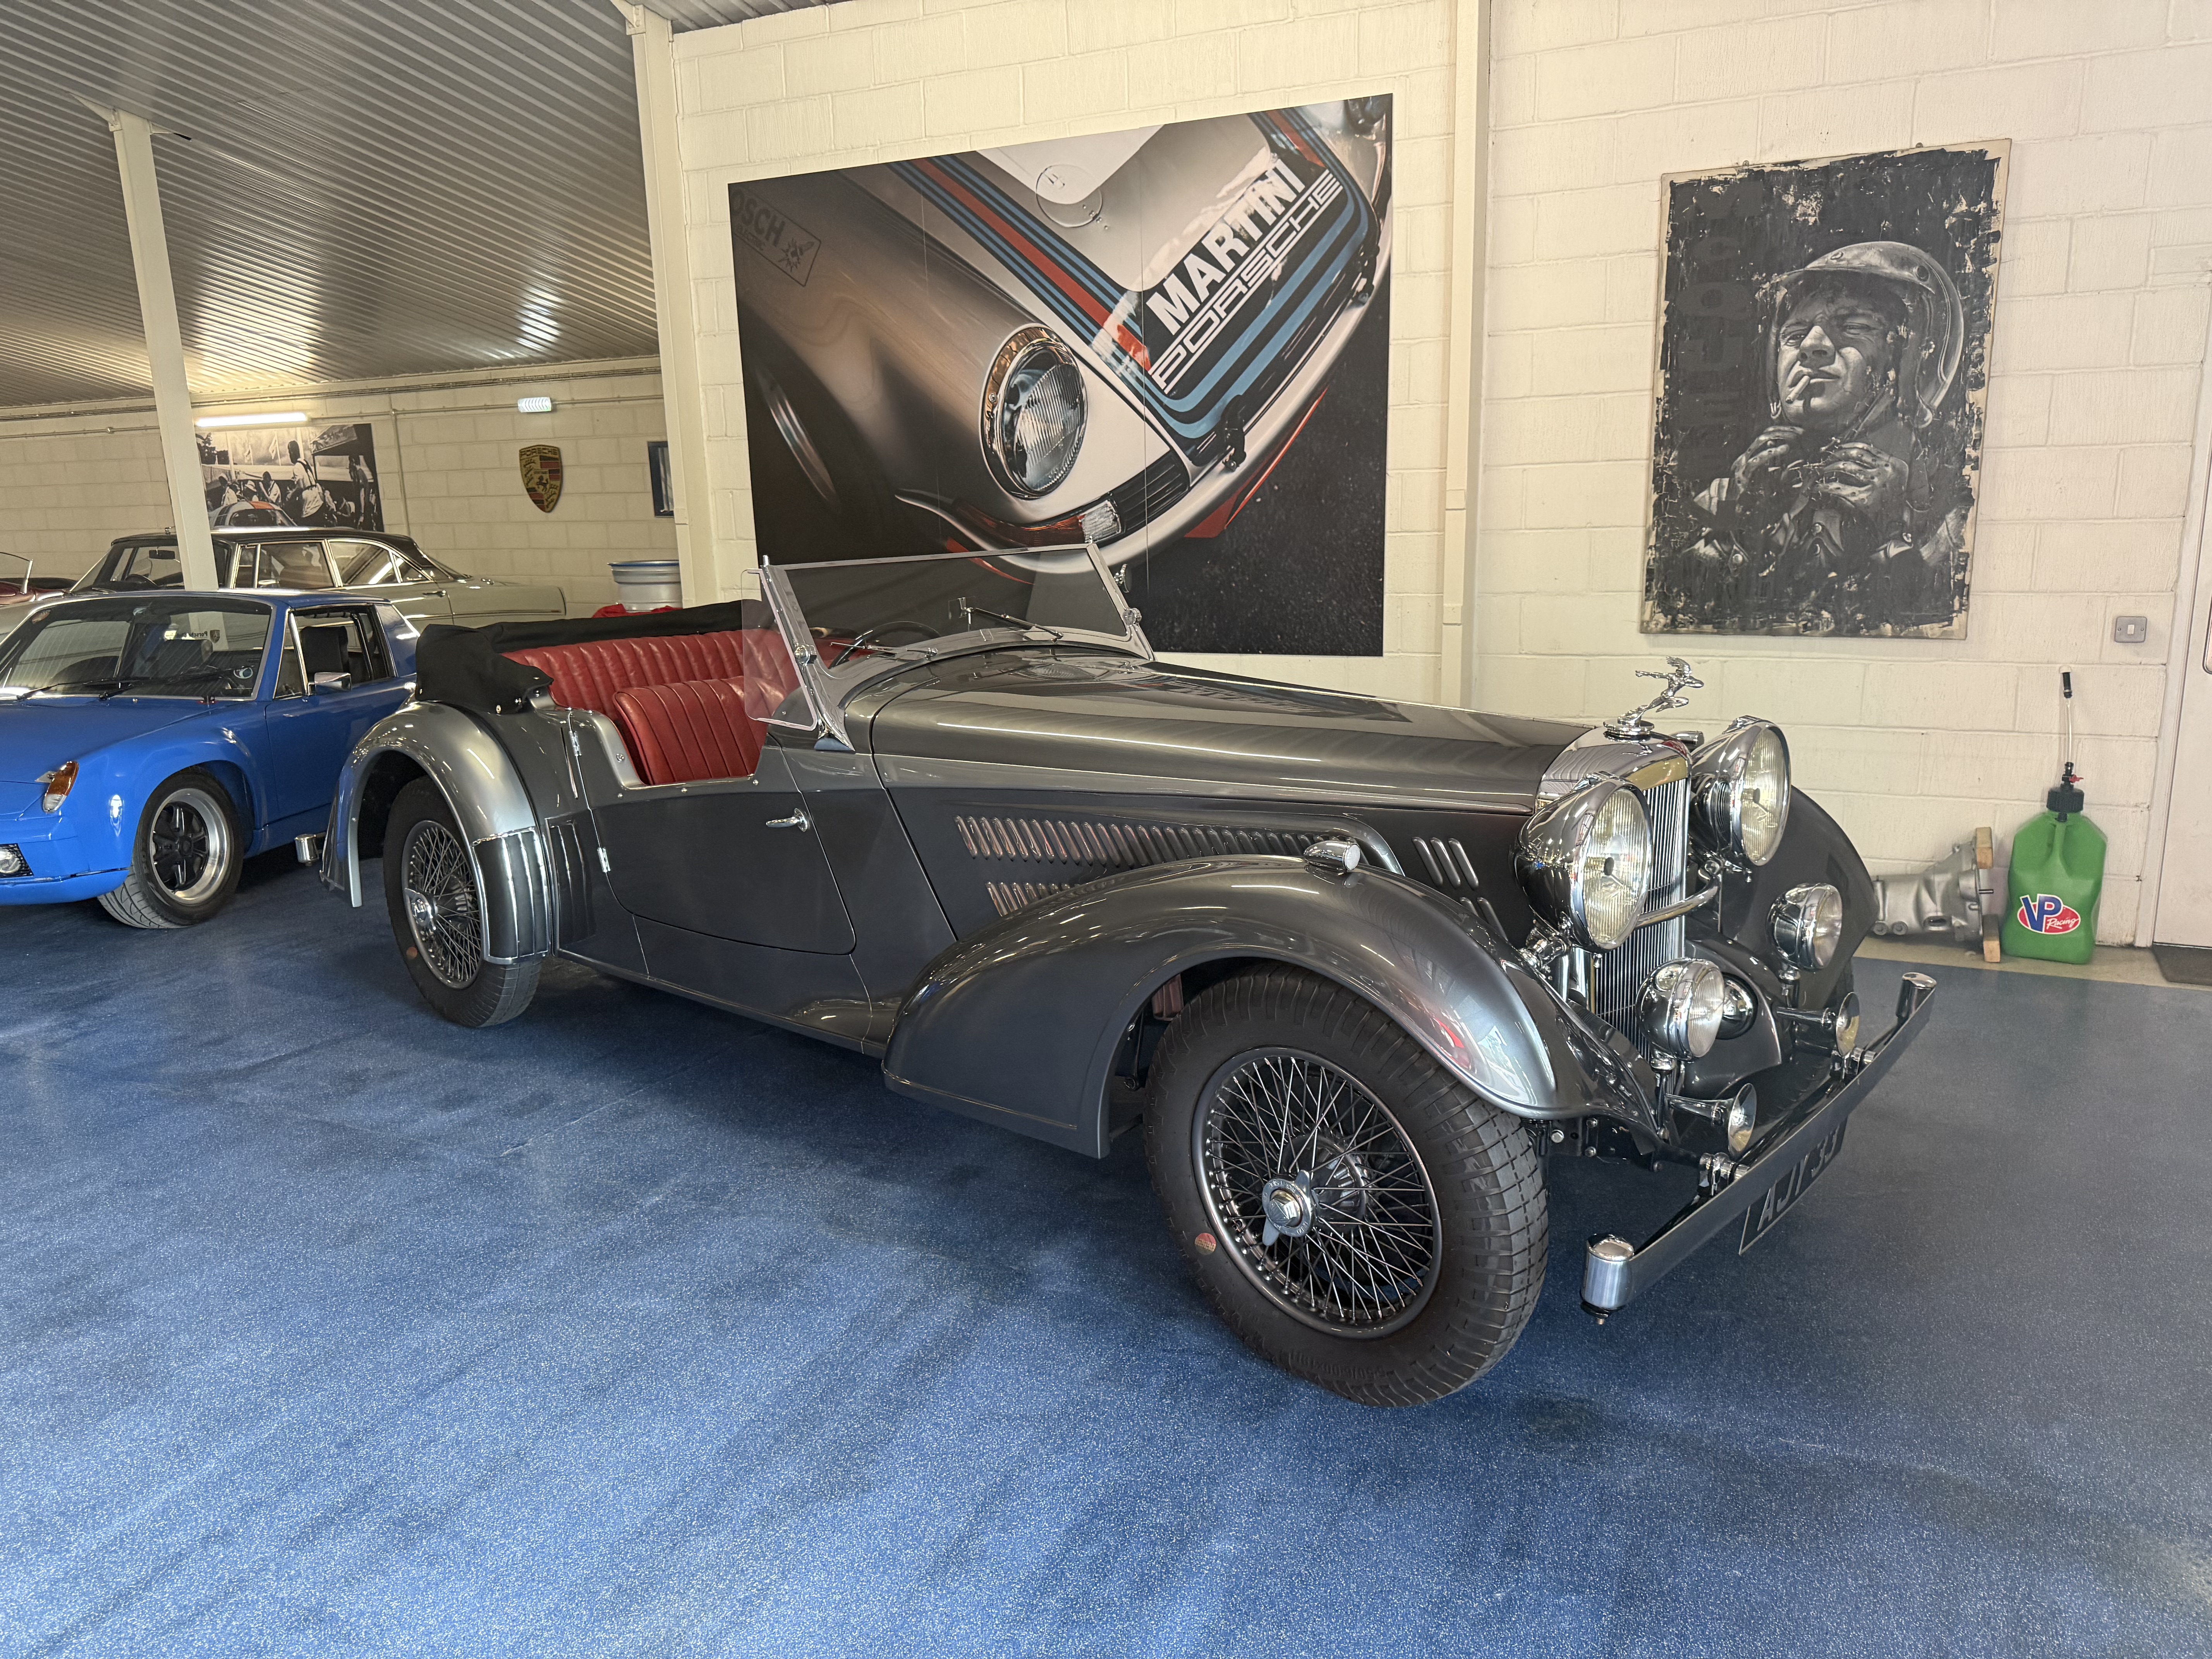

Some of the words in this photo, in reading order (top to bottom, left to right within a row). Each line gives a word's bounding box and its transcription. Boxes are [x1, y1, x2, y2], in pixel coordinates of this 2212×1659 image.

[1146, 159, 1305, 336] MARTINI
[1148, 169, 1343, 394] PORSCHE
[2020, 894, 2063, 933] VP
[2047, 917, 2079, 930] Racing
